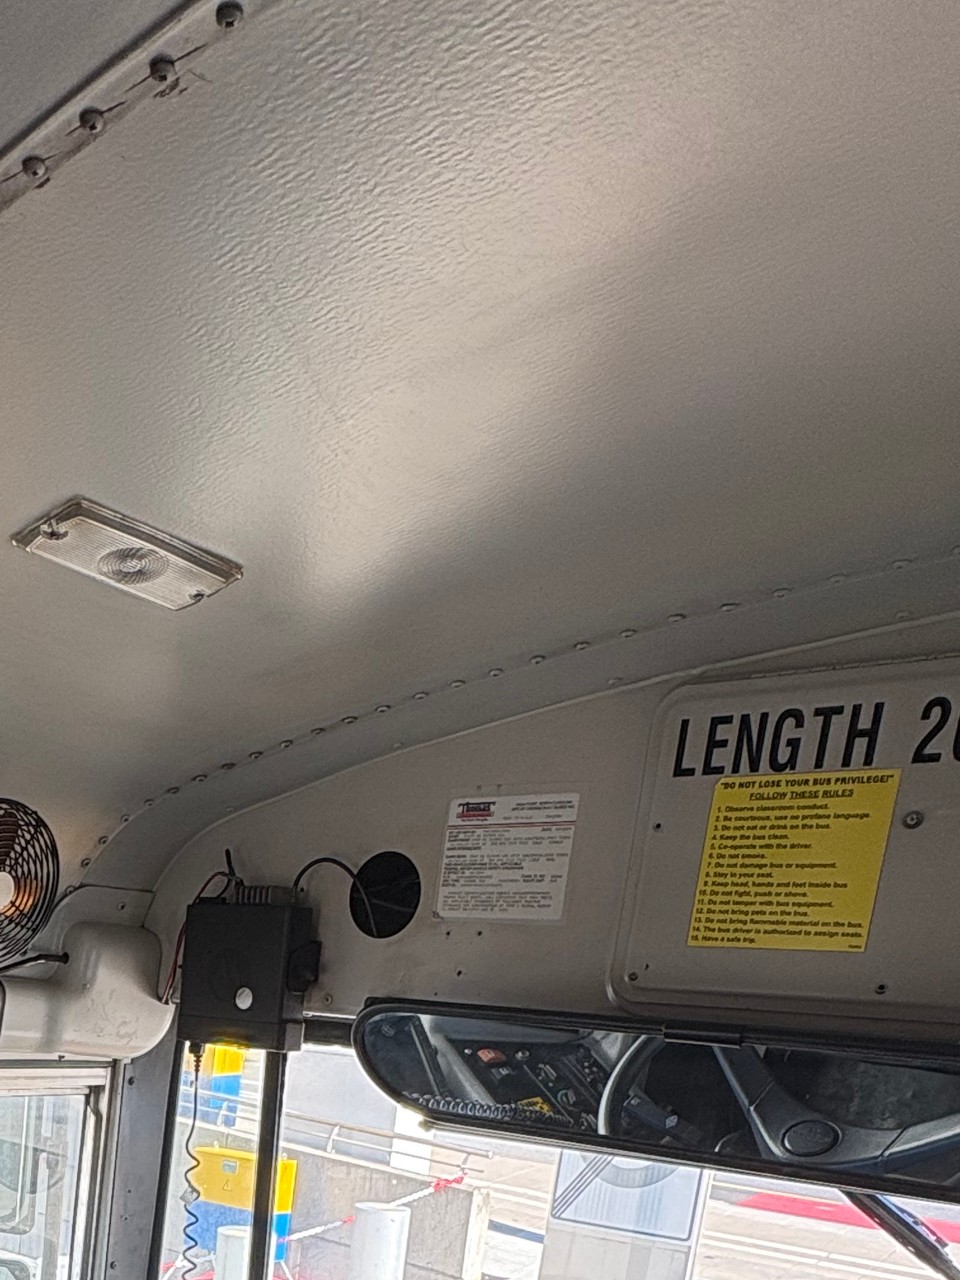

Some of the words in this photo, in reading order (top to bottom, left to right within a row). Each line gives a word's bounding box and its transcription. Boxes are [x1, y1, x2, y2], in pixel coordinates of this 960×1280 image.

[672, 702, 886, 778] LENGTH
[738, 781, 756, 789] NOT
[785, 779, 810, 787] YOUR
[812, 778, 832, 786] BUS
[749, 792, 788, 801] FOLLOW
[789, 790, 820, 800] THESE
[822, 789, 854, 798] RULES
[720, 834, 738, 842] Keep
[712, 881, 729, 889] Keep
